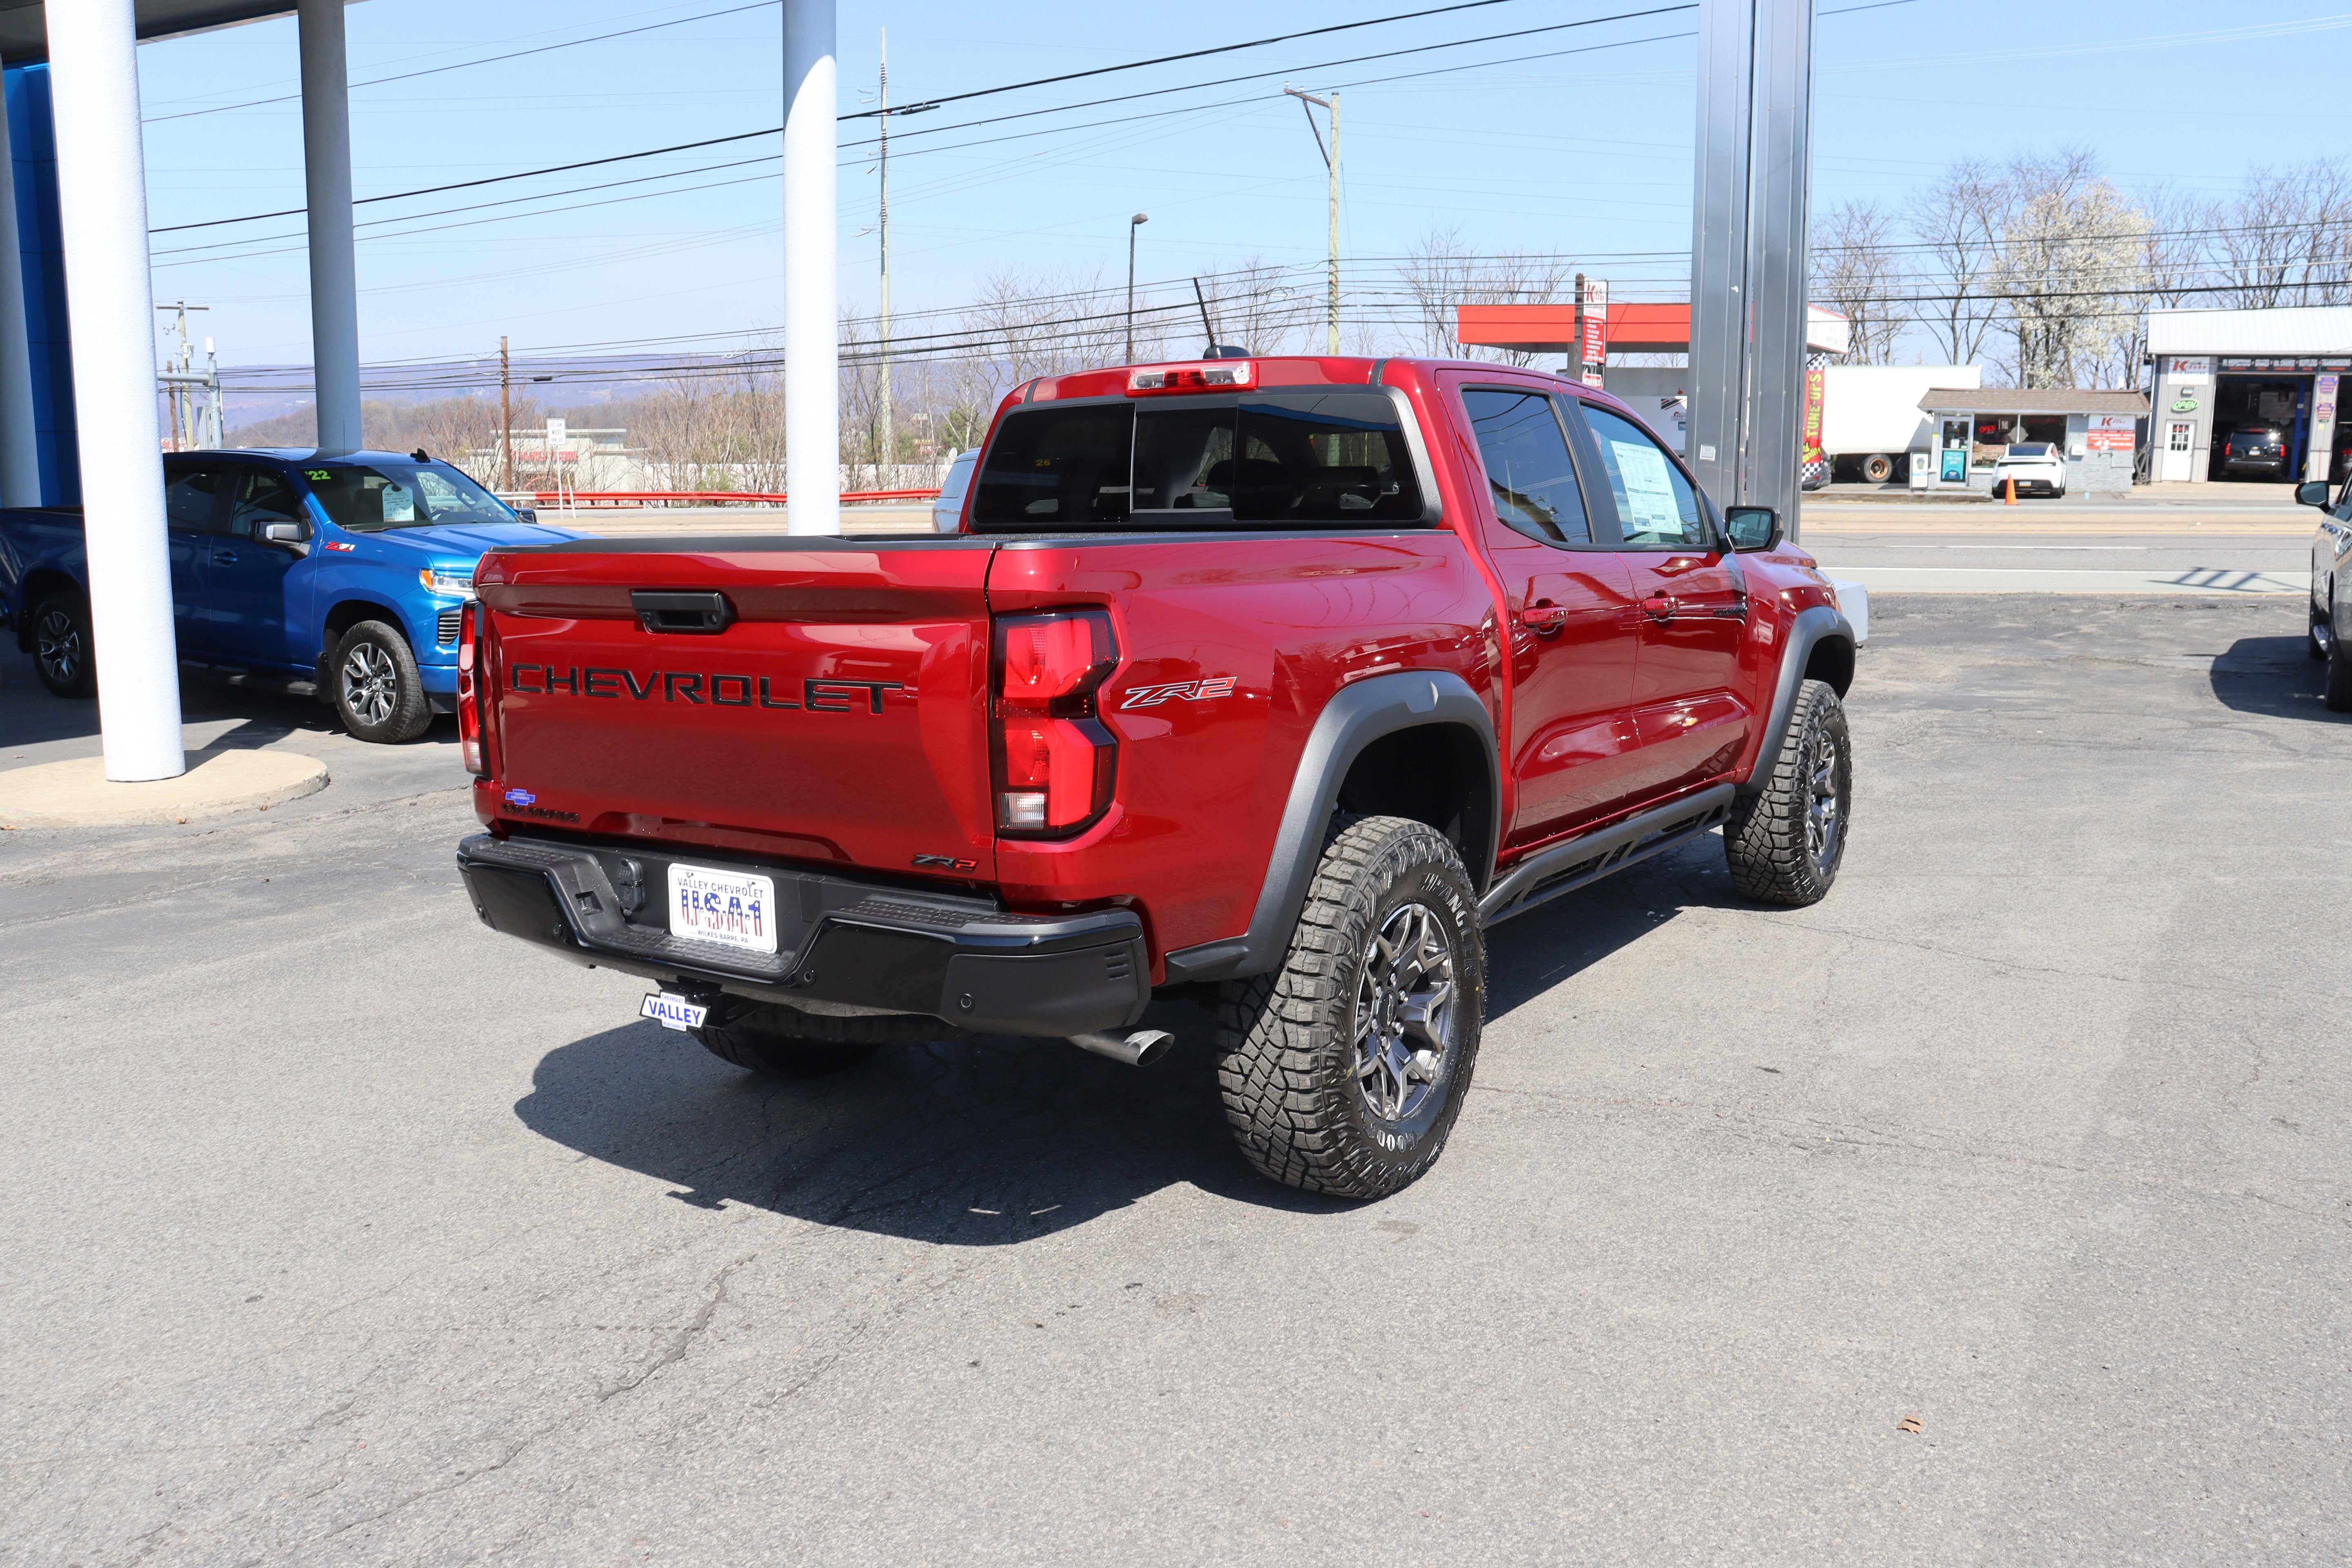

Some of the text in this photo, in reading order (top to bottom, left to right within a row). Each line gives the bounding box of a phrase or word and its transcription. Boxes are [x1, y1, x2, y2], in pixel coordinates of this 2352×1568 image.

[1806, 373, 1822, 439] TUNE-UPS
[1979, 424, 1996, 433] OPEN
[305, 470, 331, 481] '22
[325, 541, 356, 552] Z71
[511, 662, 903, 715] CHEVROLET
[1120, 676, 1237, 710] ZR2
[501, 803, 579, 822] COLORADO
[911, 853, 978, 871] ZR2
[677, 878, 763, 898] VALLEY CHEVROLET
[662, 994, 684, 1004] CHEVROLET
[648, 1000, 701, 1025] VALLEY
